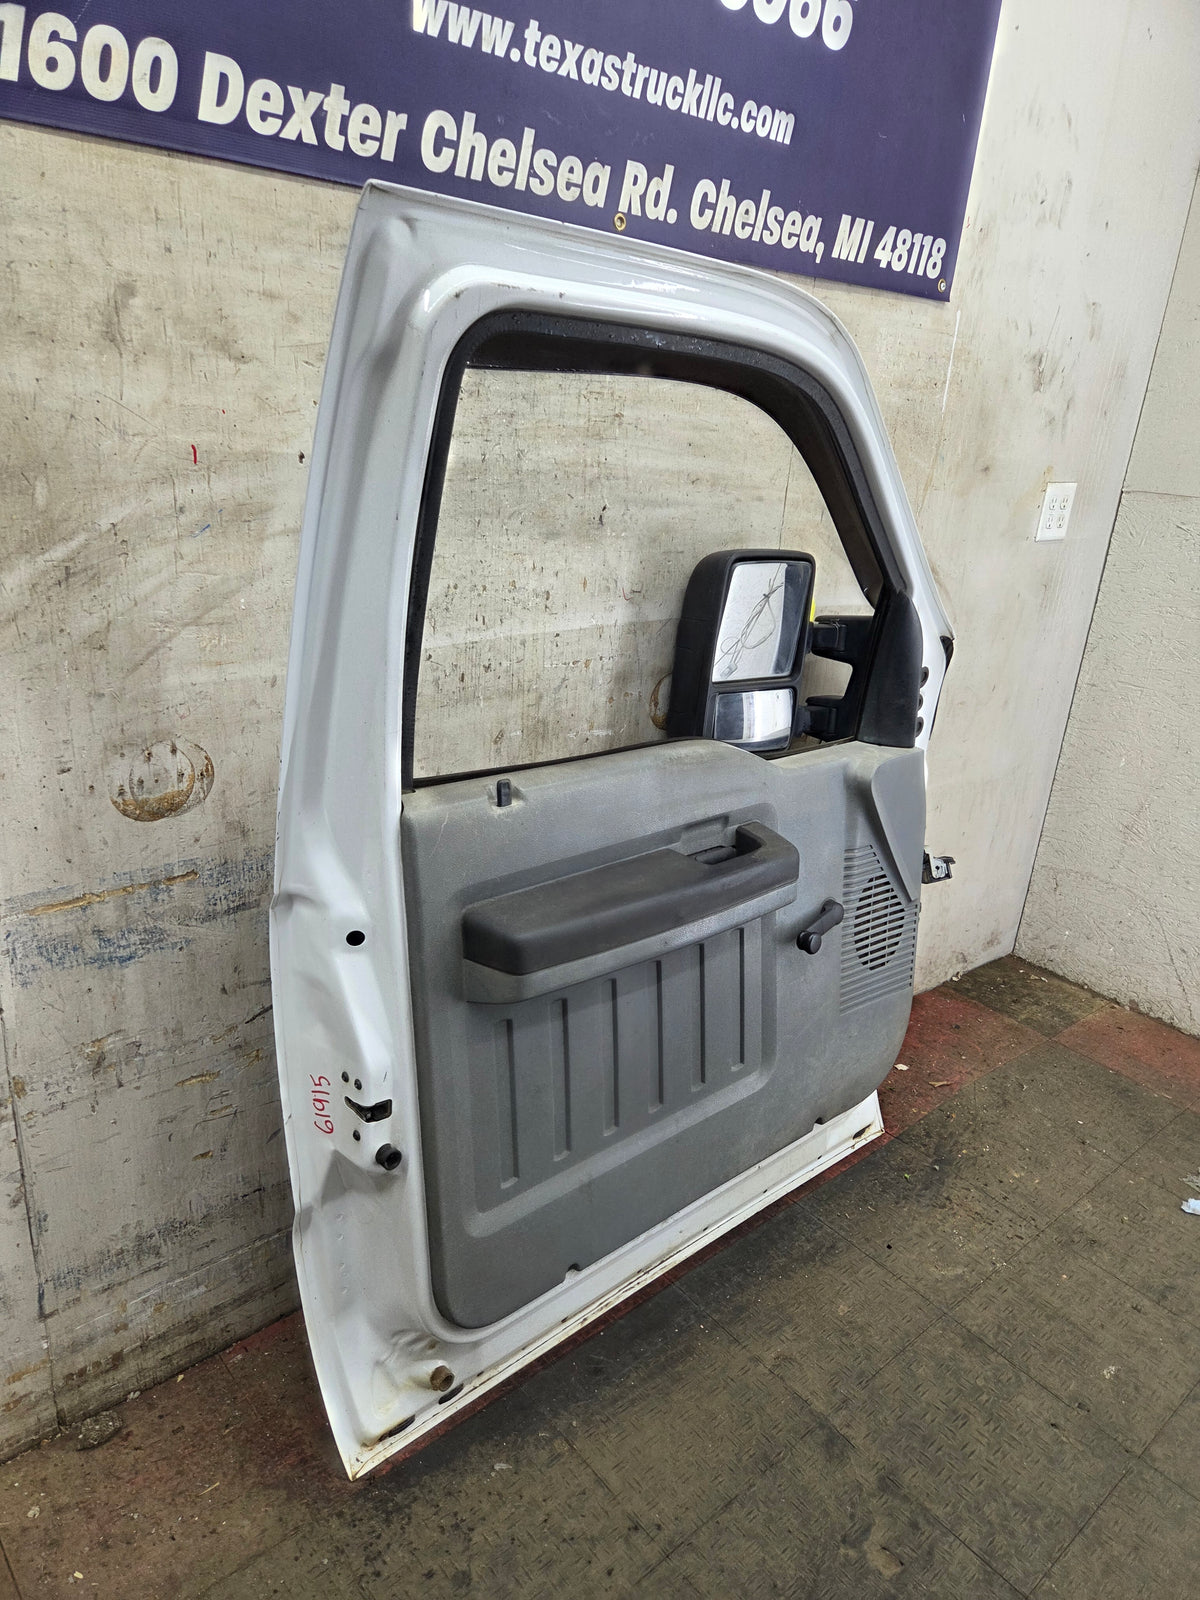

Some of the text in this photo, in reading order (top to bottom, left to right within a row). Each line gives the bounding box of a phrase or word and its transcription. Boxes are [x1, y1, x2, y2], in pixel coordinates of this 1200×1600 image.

[0, 3, 947, 280] 1600 Dexter Chelsea Rd. Chelsea, MI 48118
[412, 0, 795, 145] www.texastruckllc.com
[309, 1074, 334, 1134] 61915
